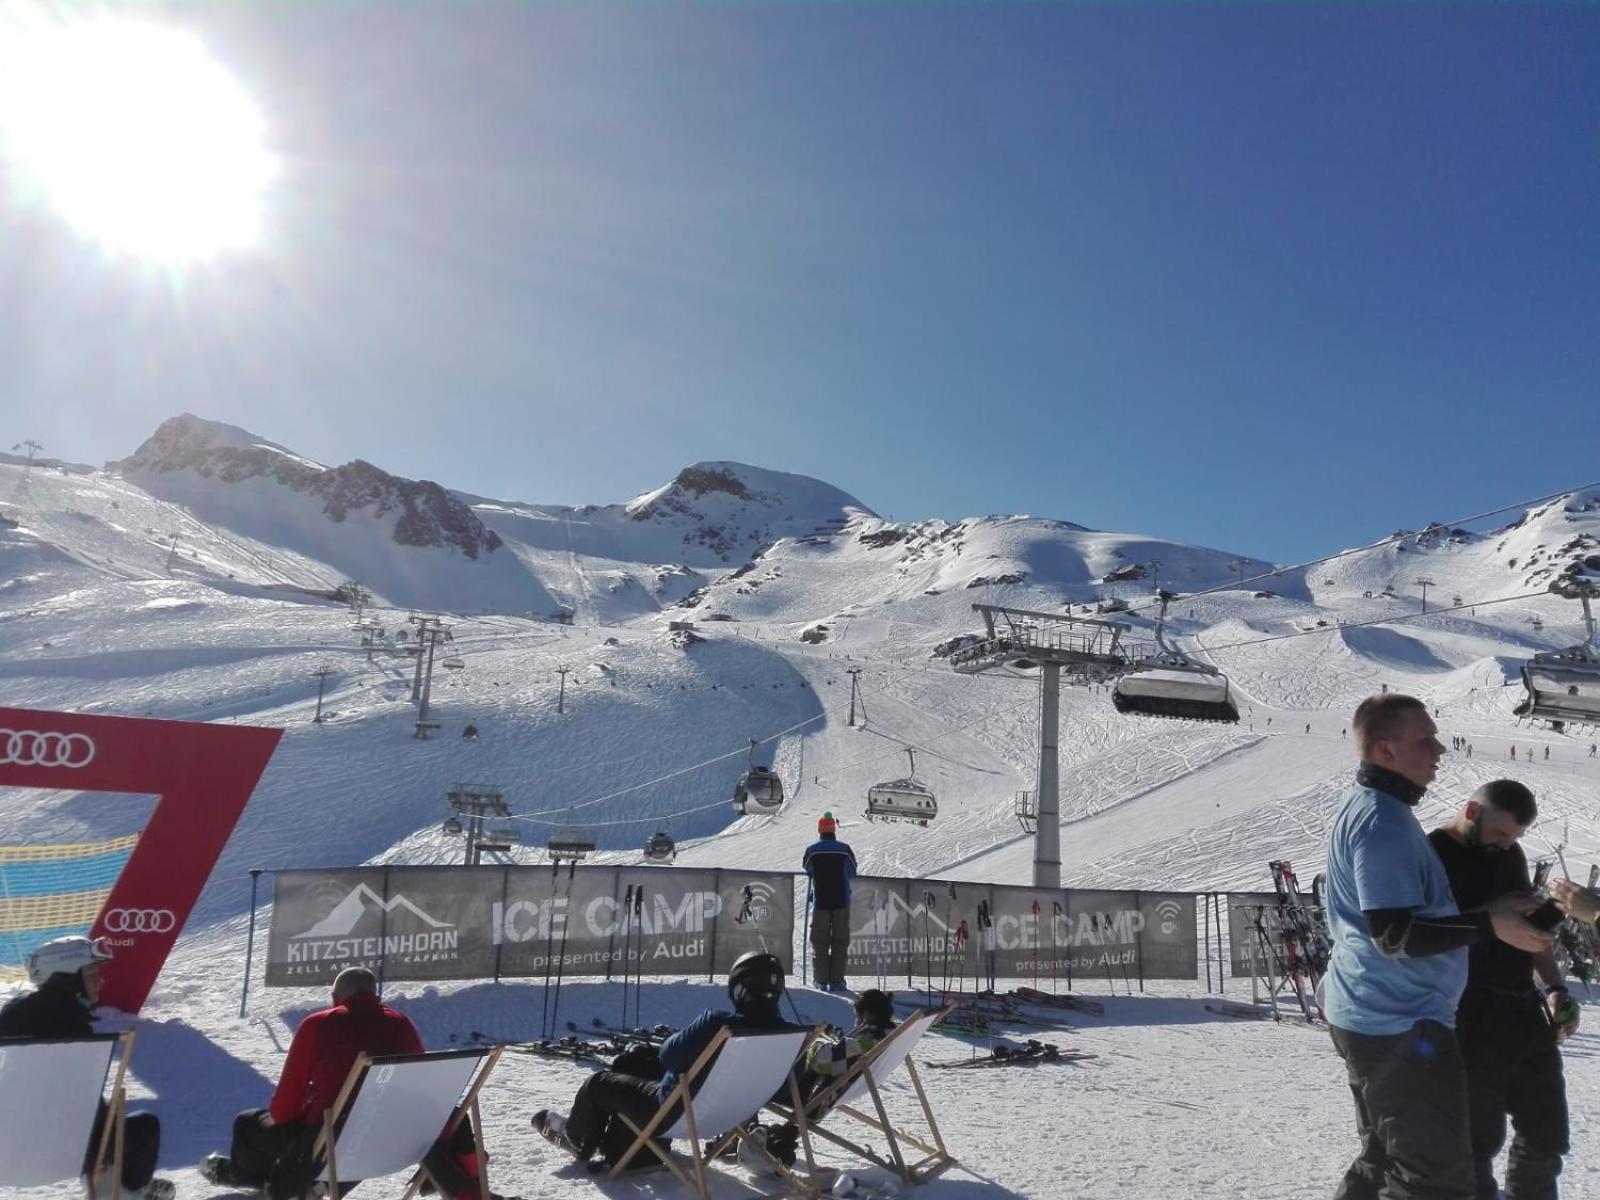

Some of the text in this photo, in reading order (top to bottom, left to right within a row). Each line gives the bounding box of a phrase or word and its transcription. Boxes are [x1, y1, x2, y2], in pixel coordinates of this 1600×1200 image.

[492, 891, 723, 945] ICE CAMP
[1052, 910, 1145, 947] CAMP
[287, 931, 458, 962] KITZSTEINHORN
[533, 939, 705, 969] presented by Audi
[1016, 957, 1078, 973] presented
[1081, 956, 1095, 970] by
[1098, 950, 1136, 966] Audi
[287, 964, 321, 975] ZELL
